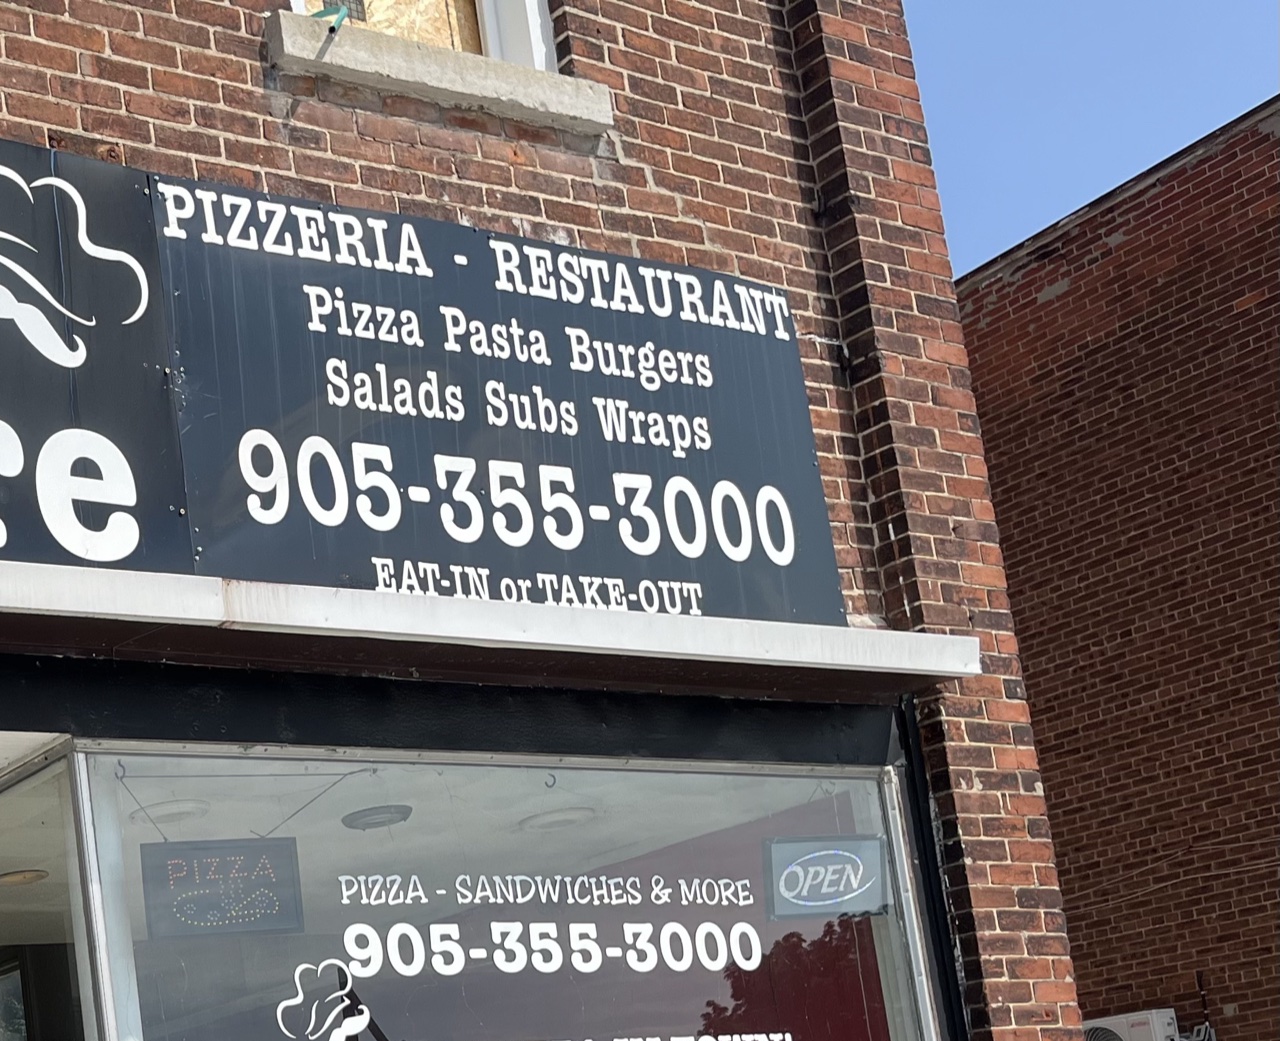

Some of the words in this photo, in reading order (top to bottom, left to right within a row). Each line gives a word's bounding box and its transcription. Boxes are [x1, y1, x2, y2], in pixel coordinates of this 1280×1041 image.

[157, 182, 434, 278] PIZZERIA
[489, 239, 791, 342] RESTAURANT
[303, 284, 424, 348] Pizza
[440, 305, 551, 367] Pasta
[565, 326, 714, 392] Burgers
[326, 357, 465, 422] Salads
[485, 379, 578, 437] Subs
[592, 396, 712, 459] Wraps
[238, 428, 795, 567] 905-355-3000
[371, 556, 490, 602] EAT-IN
[500, 577, 532, 604] or
[537, 572, 703, 617] TAKE-OUT
[167, 855, 276, 889] PIZZA
[338, 874, 429, 906] PIZZA
[455, 874, 643, 906] SANDWICHES
[650, 874, 673, 905] &
[678, 878, 754, 907] MORE
[779, 863, 864, 898] OPEN
[342, 921, 762, 978] 905-355-3000
